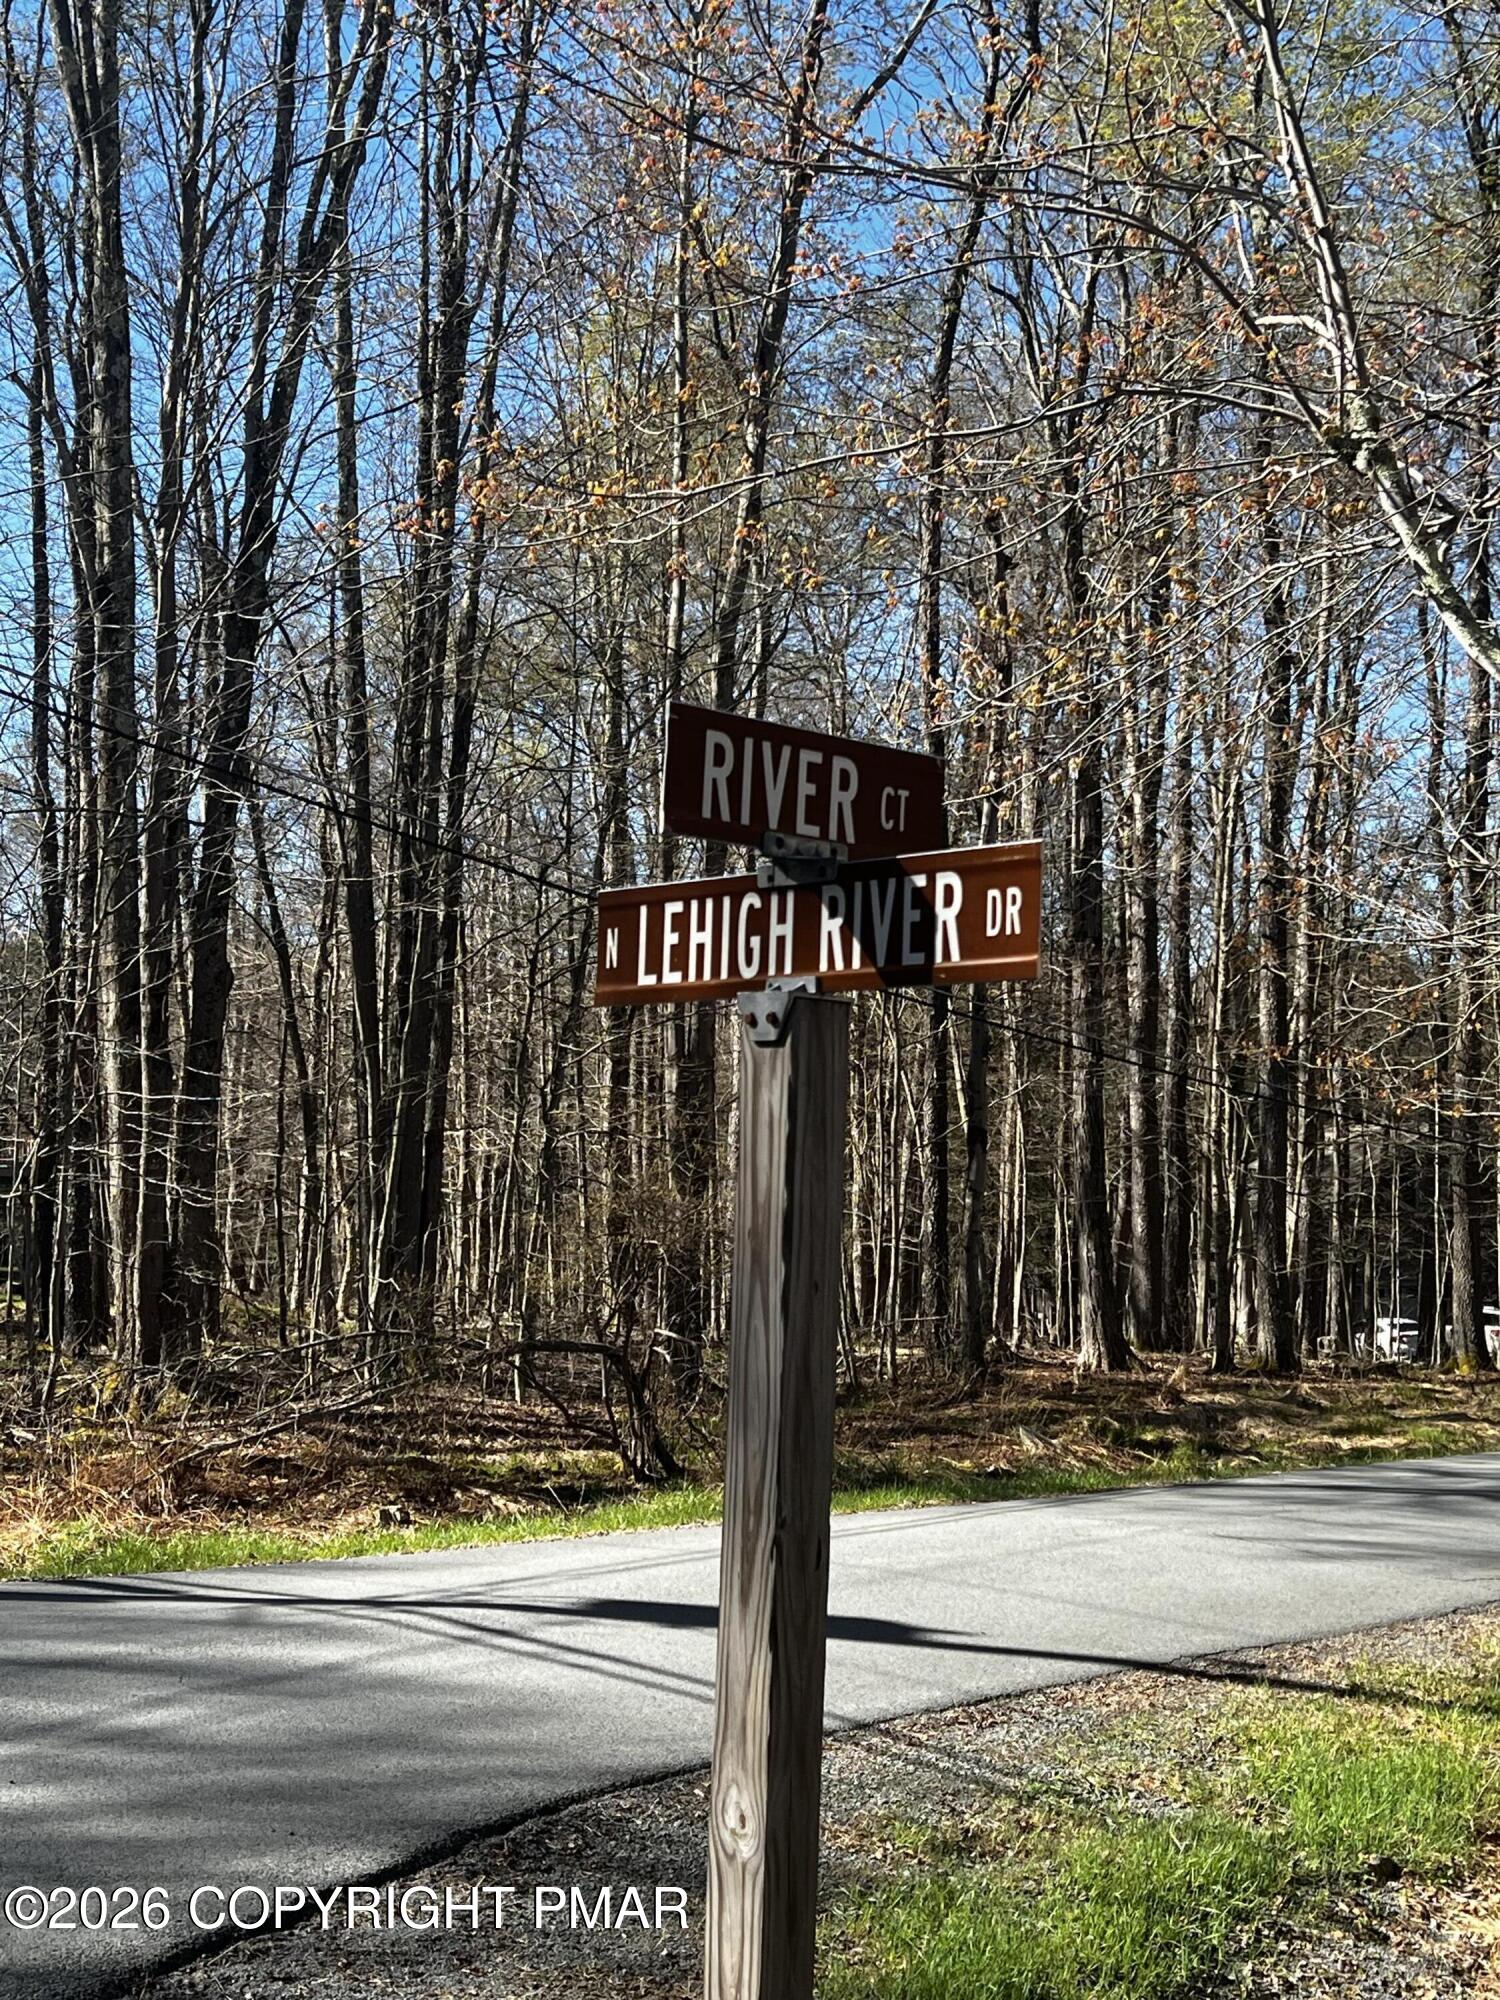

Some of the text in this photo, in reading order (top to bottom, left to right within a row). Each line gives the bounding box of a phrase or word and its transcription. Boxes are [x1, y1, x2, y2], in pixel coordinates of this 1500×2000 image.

[702, 729, 910, 844] RIVER CT
[605, 870, 1022, 986] N LEHIGH RIVER DR
